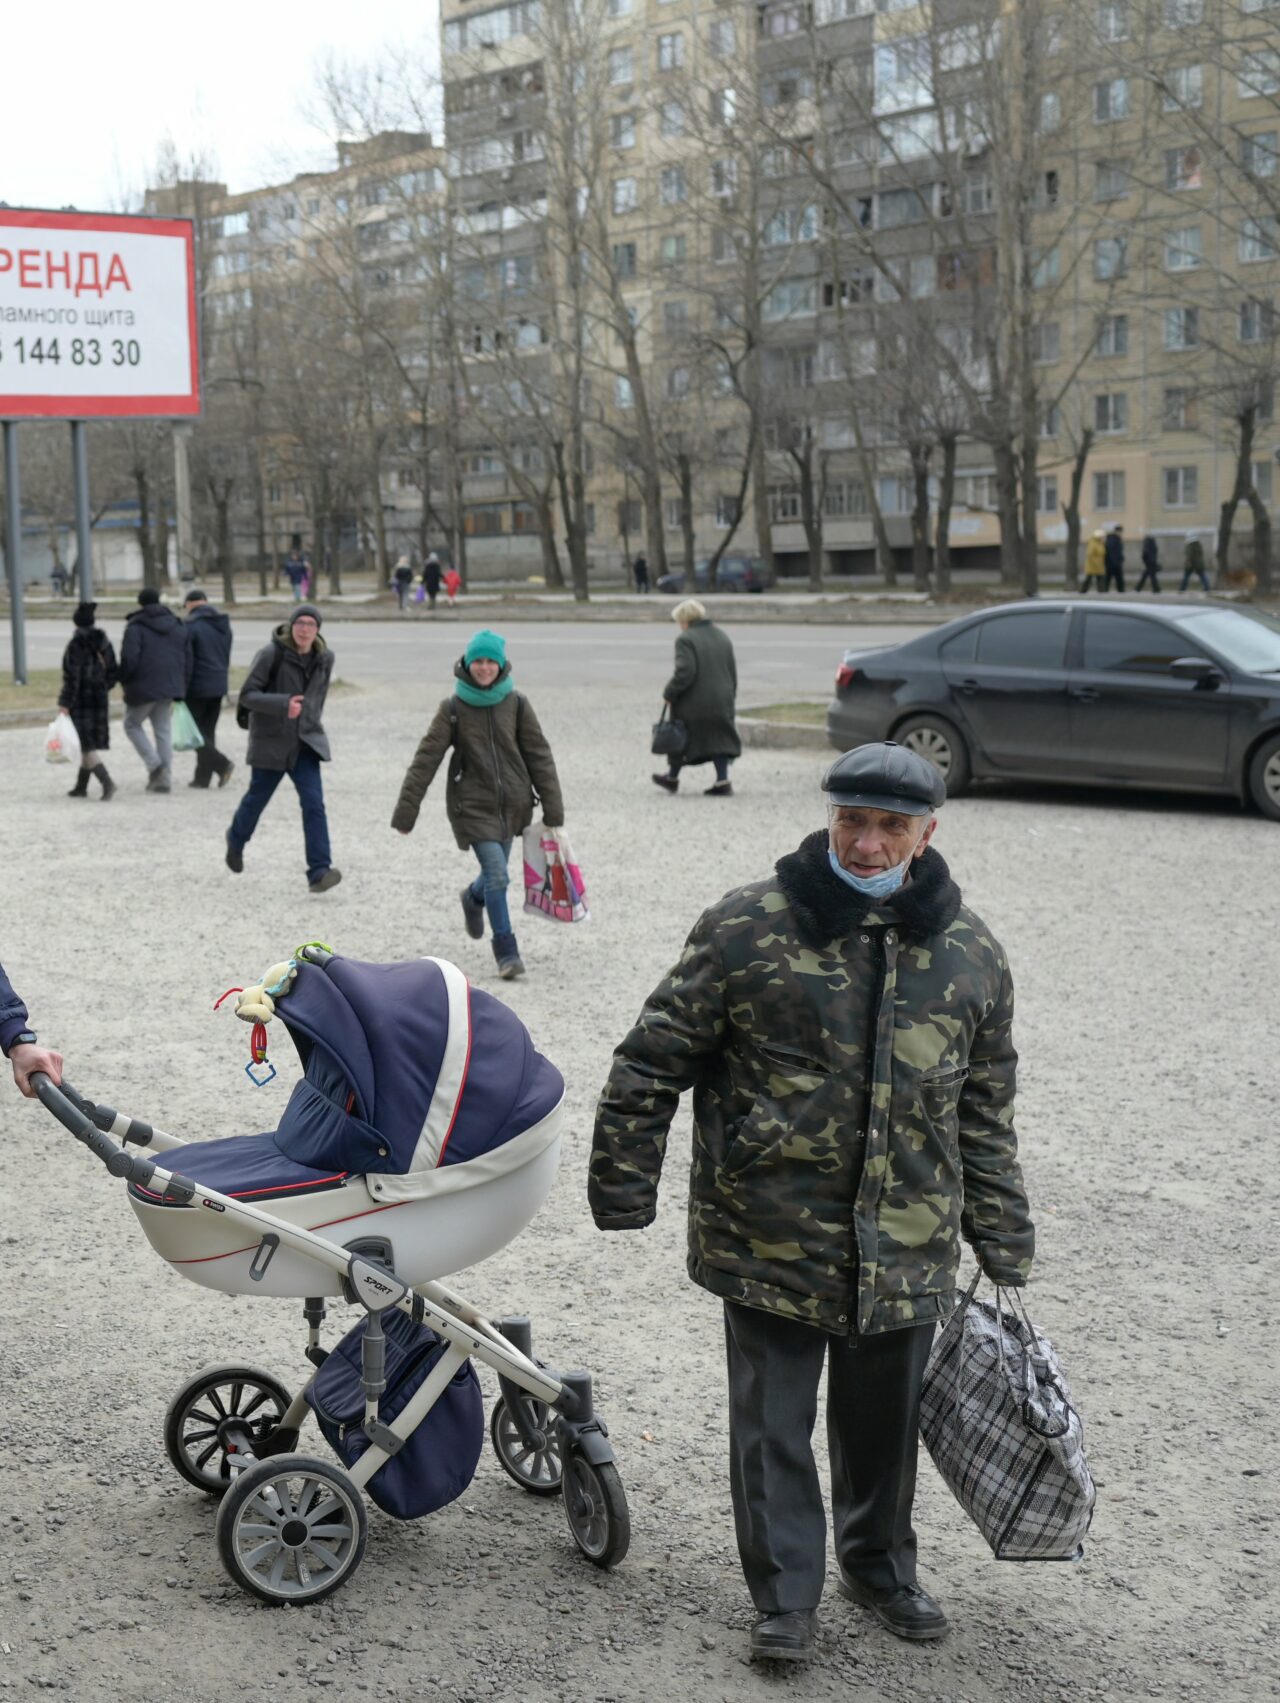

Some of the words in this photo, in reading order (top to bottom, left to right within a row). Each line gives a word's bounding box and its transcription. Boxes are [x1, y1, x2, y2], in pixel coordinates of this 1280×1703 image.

[85, 307, 135, 328] щита
[14, 337, 61, 366] 144
[71, 338, 102, 366] 83
[111, 339, 141, 367] 30
[363, 1276, 393, 1294] SPORT
